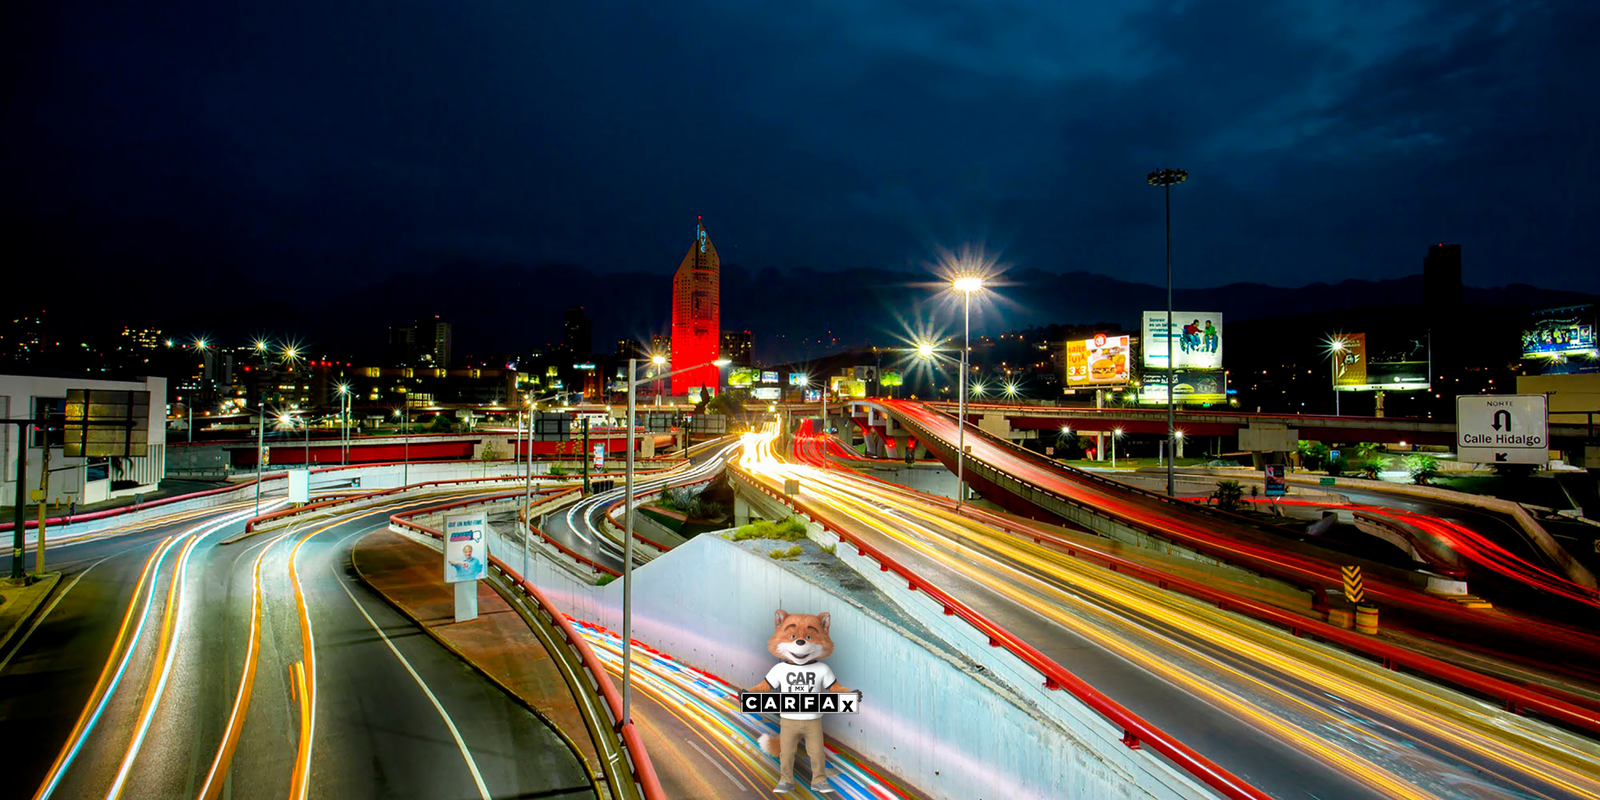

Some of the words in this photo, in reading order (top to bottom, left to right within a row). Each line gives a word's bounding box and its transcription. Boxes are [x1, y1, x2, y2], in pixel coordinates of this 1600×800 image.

[1463, 434, 1492, 443] Calle
[1495, 434, 1541, 446] Hidalgo
[786, 671, 816, 686] CAR
